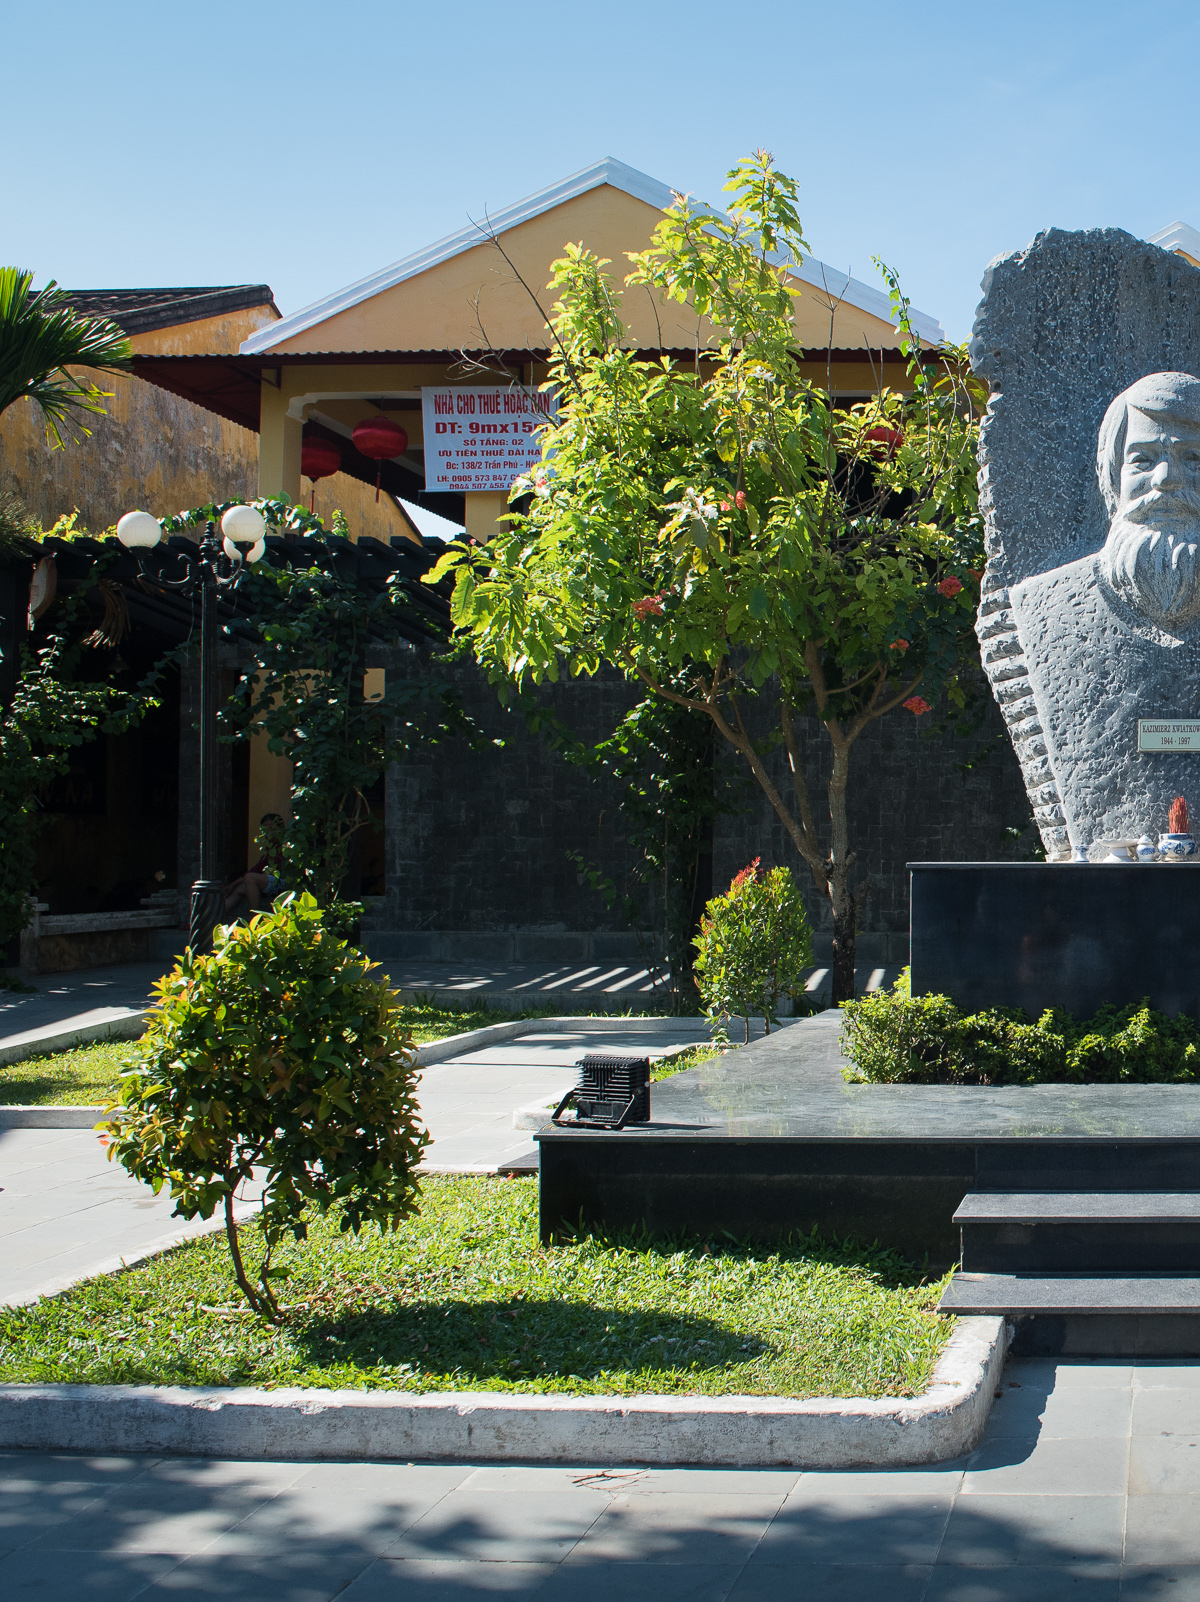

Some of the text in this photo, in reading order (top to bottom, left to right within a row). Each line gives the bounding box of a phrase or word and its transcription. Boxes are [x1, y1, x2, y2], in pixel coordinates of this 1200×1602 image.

[434, 390, 454, 415] NHÀ
[457, 394, 476, 415] CHO
[477, 390, 501, 415] THUÊ
[435, 422, 463, 434] DT:
[463, 437, 477, 446] SỐ
[511, 438, 524, 446] 02
[455, 449, 477, 457] TIÊN
[480, 448, 505, 457] THUÊ
[507, 448, 525, 456] DÀI
[527, 448, 542, 458] HẠ
[461, 461, 483, 470] 138/2
[437, 475, 450, 483] LH:
[1142, 724, 1171, 733] KAZIMIERZ
[1161, 736, 1173, 745] 1944
[1178, 736, 1191, 745] 1997
